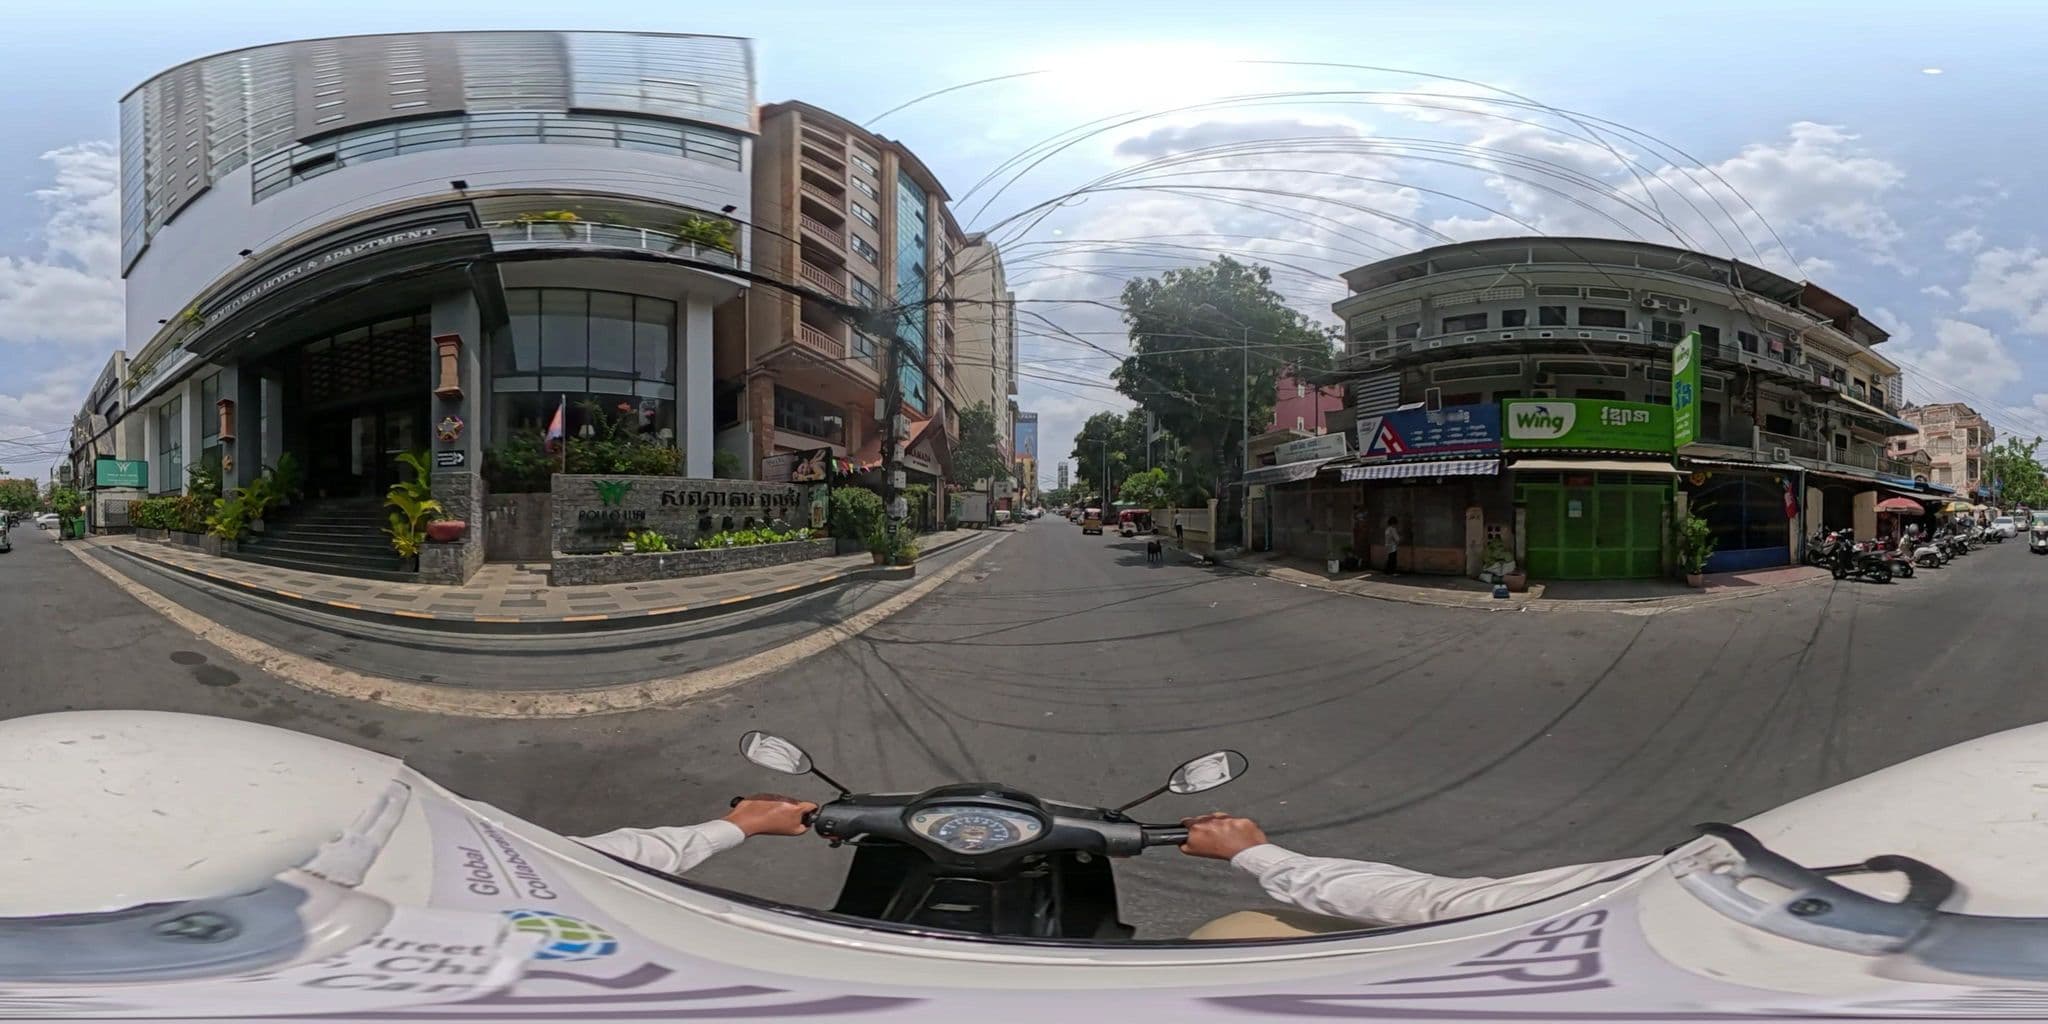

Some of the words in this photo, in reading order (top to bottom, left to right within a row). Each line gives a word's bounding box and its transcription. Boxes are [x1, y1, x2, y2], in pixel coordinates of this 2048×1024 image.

[323, 227, 438, 264] APARTMENT
[1516, 412, 1565, 434] Wing
[457, 845, 500, 896] Global
